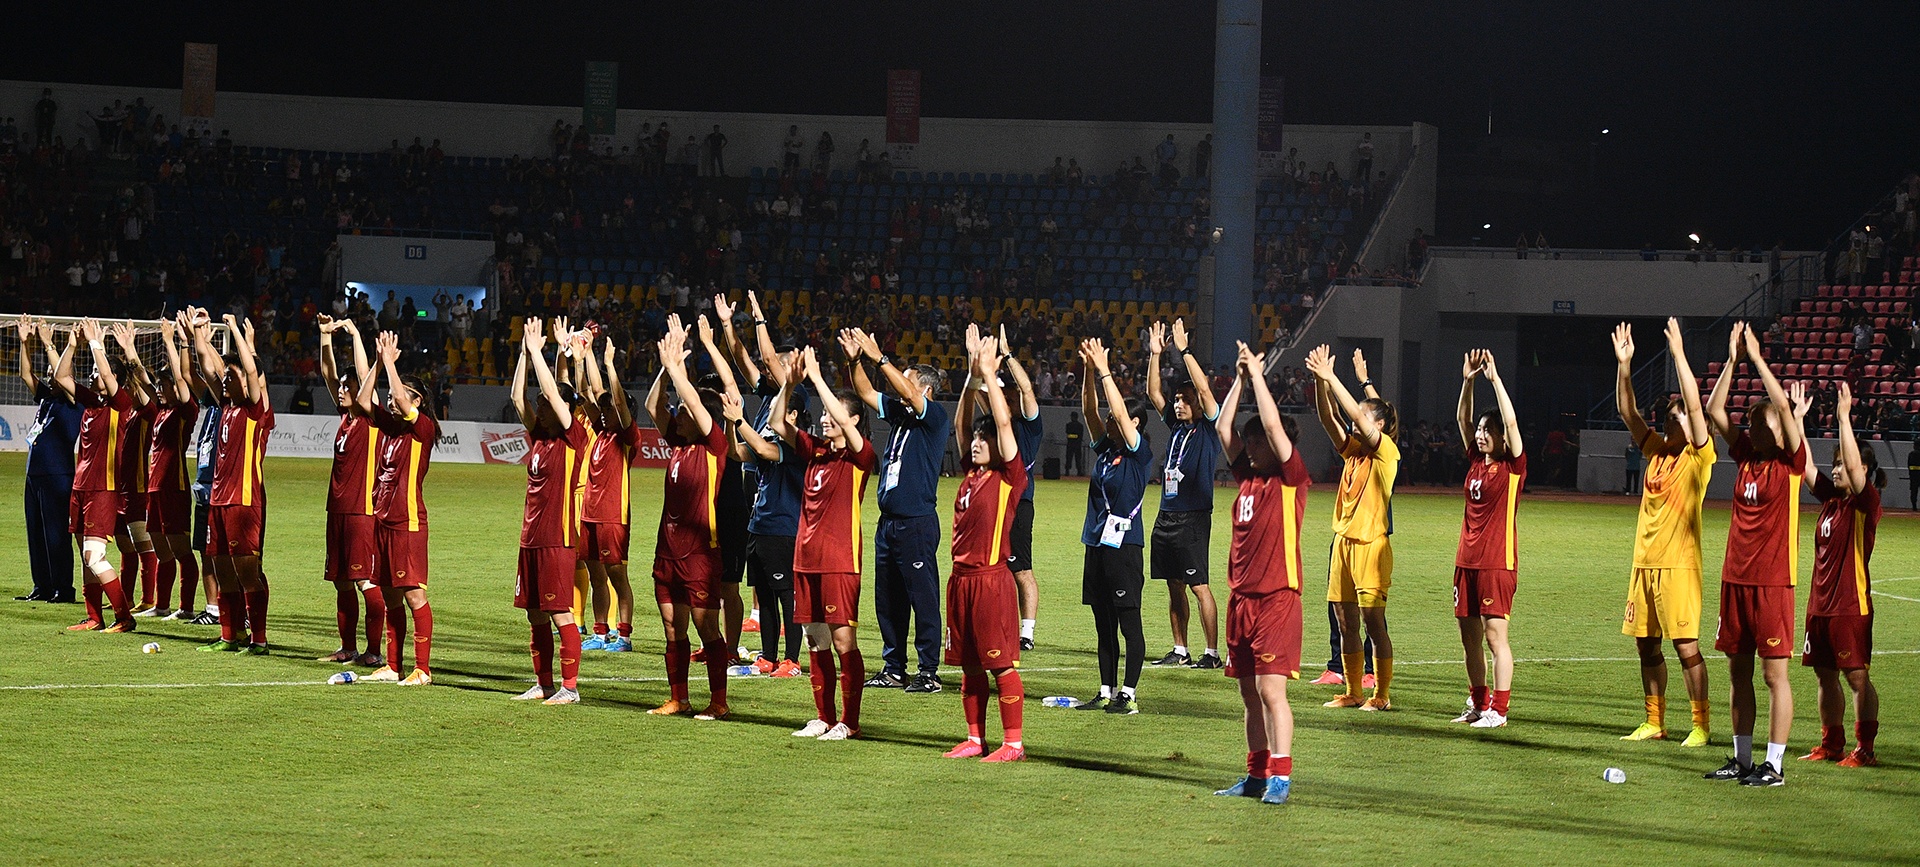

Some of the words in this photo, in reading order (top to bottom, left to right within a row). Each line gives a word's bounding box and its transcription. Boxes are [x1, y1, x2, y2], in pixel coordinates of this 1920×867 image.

[409, 247, 422, 258] D6
[302, 420, 332, 446] Lake
[441, 433, 459, 445] ood
[490, 444, 508, 456] BIA
[641, 446, 673, 460] SAIG
[532, 453, 540, 475] 8
[671, 461, 680, 483] 4
[813, 469, 825, 491] 5
[1469, 479, 1482, 500] 13
[1743, 482, 1758, 506] 10
[1238, 495, 1255, 522] 18
[1820, 516, 1832, 538] 16
